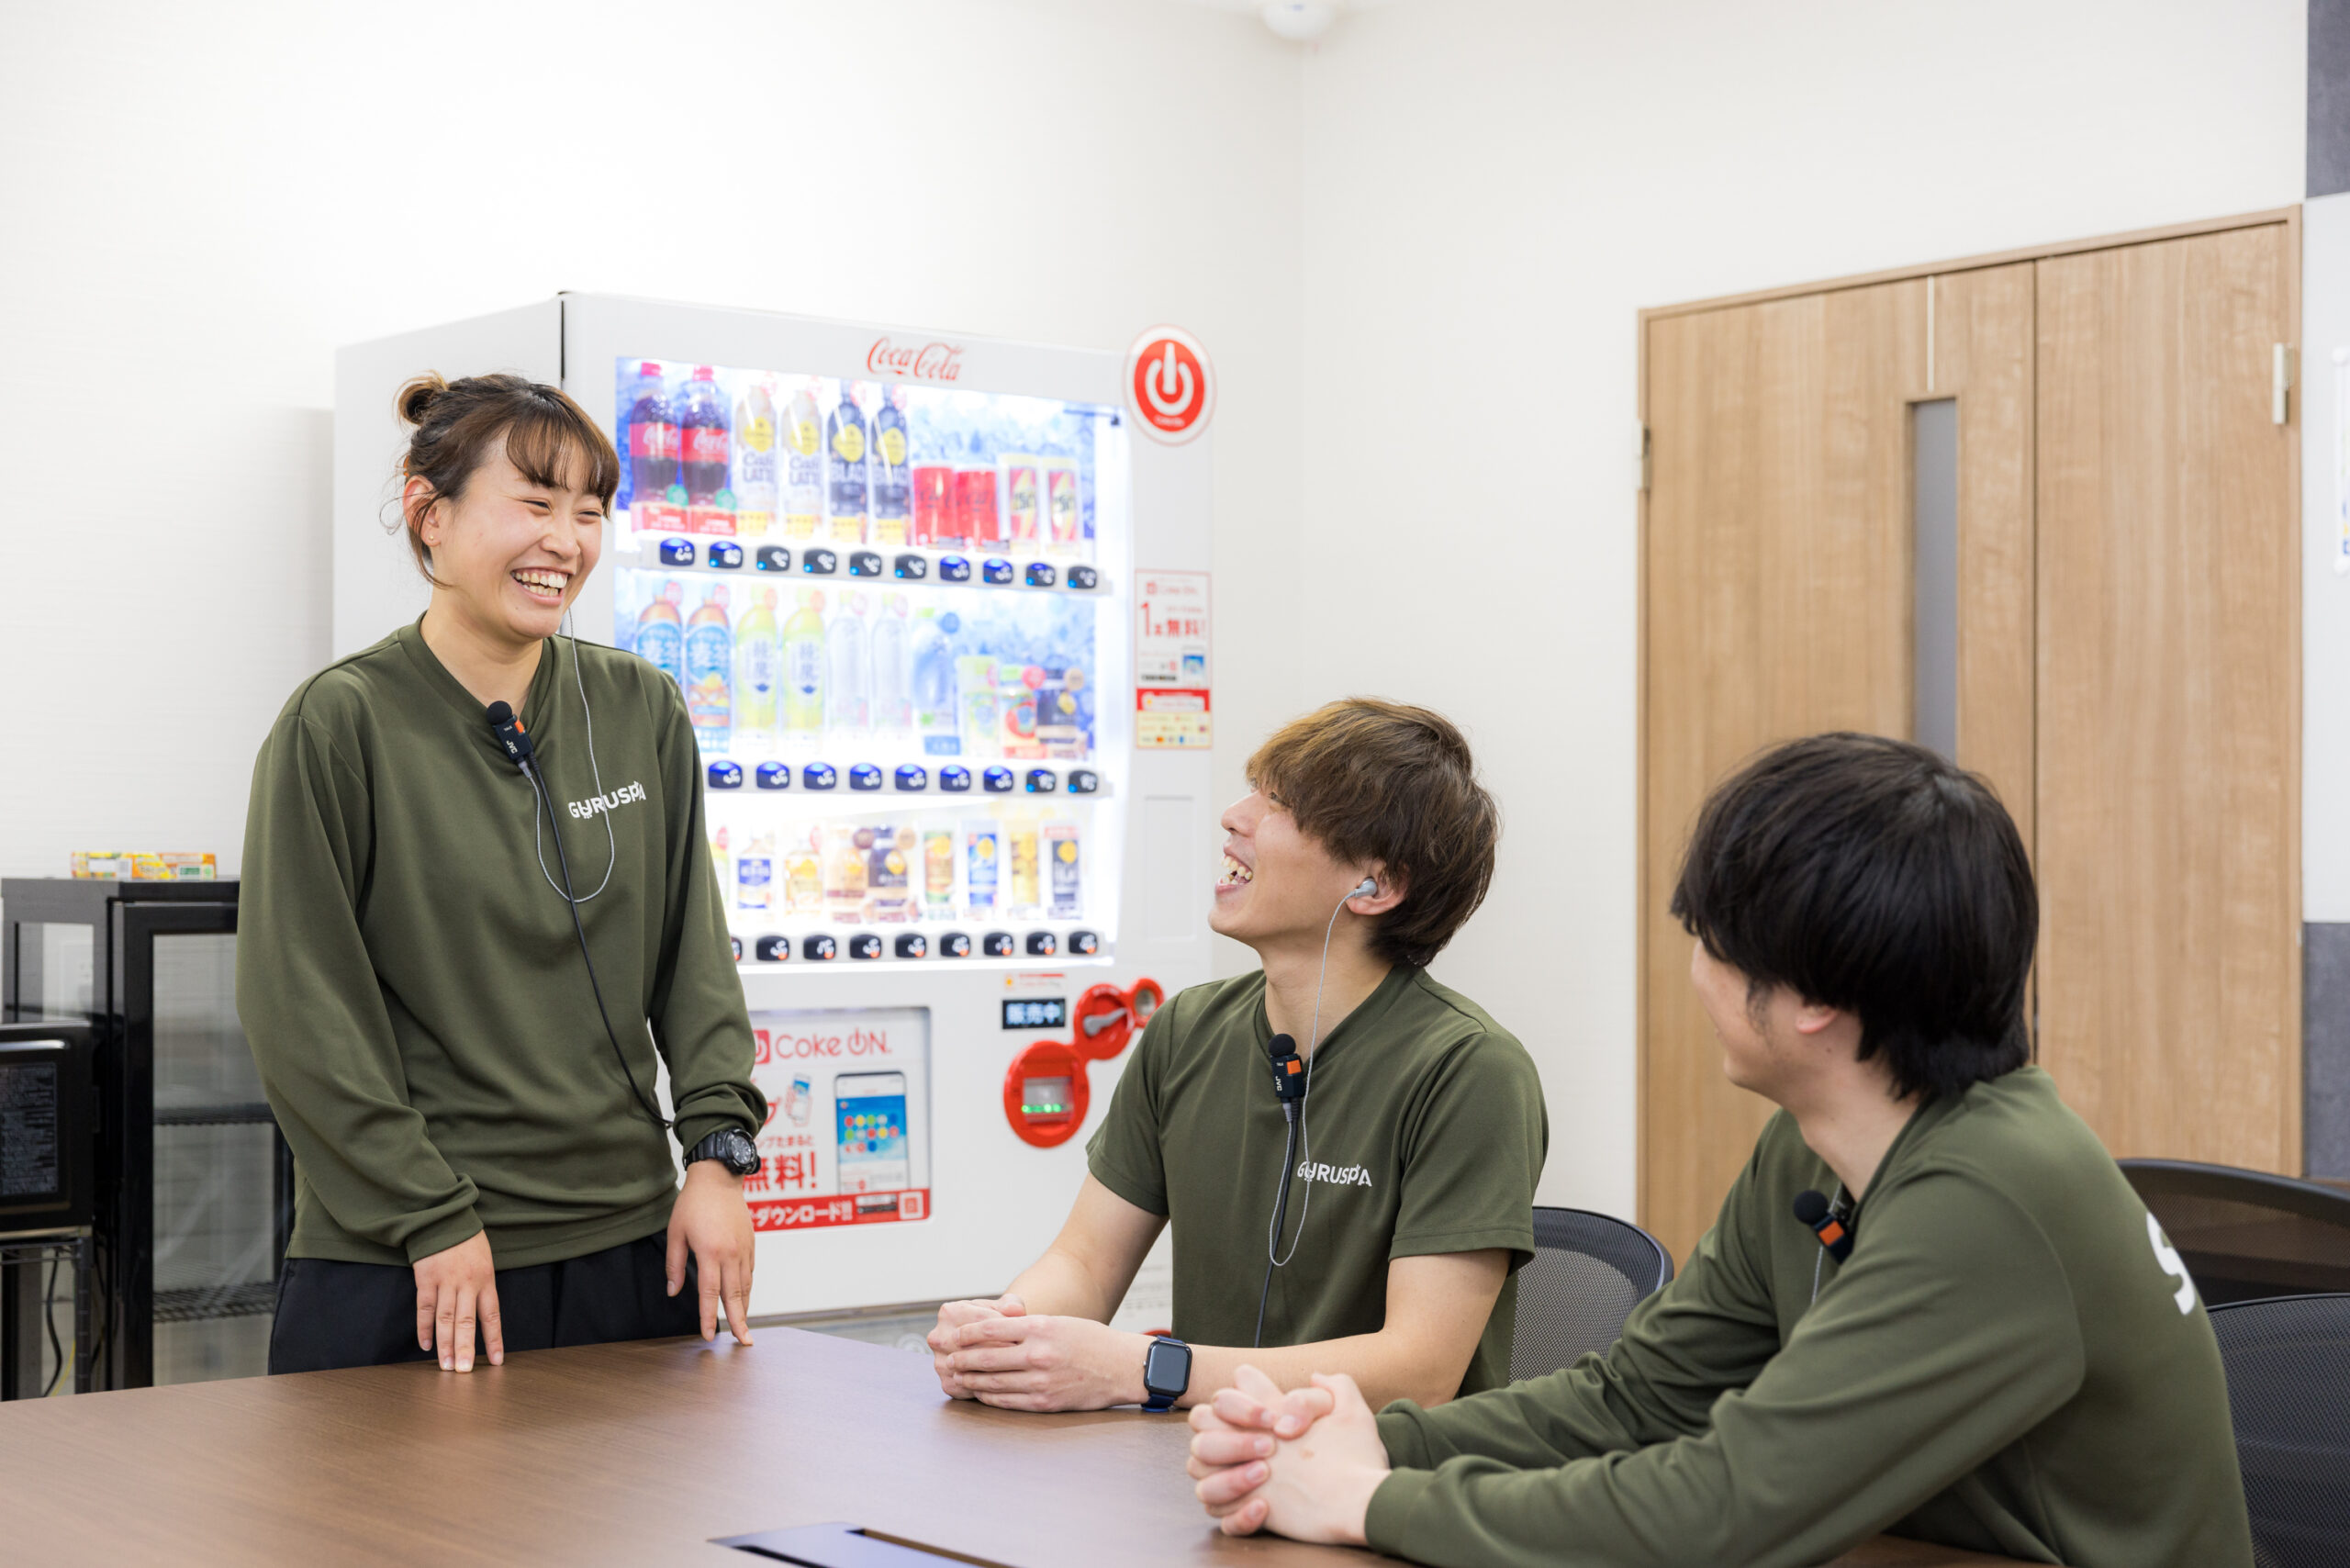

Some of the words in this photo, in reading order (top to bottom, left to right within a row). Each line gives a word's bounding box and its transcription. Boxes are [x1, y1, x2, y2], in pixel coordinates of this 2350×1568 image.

[867, 336, 964, 381] Coca-Cola
[506, 740, 518, 754] JVC
[568, 781, 646, 819] GURUSPA
[775, 1034, 842, 1058] Coke
[1297, 1160, 1372, 1187] GURUSPA
